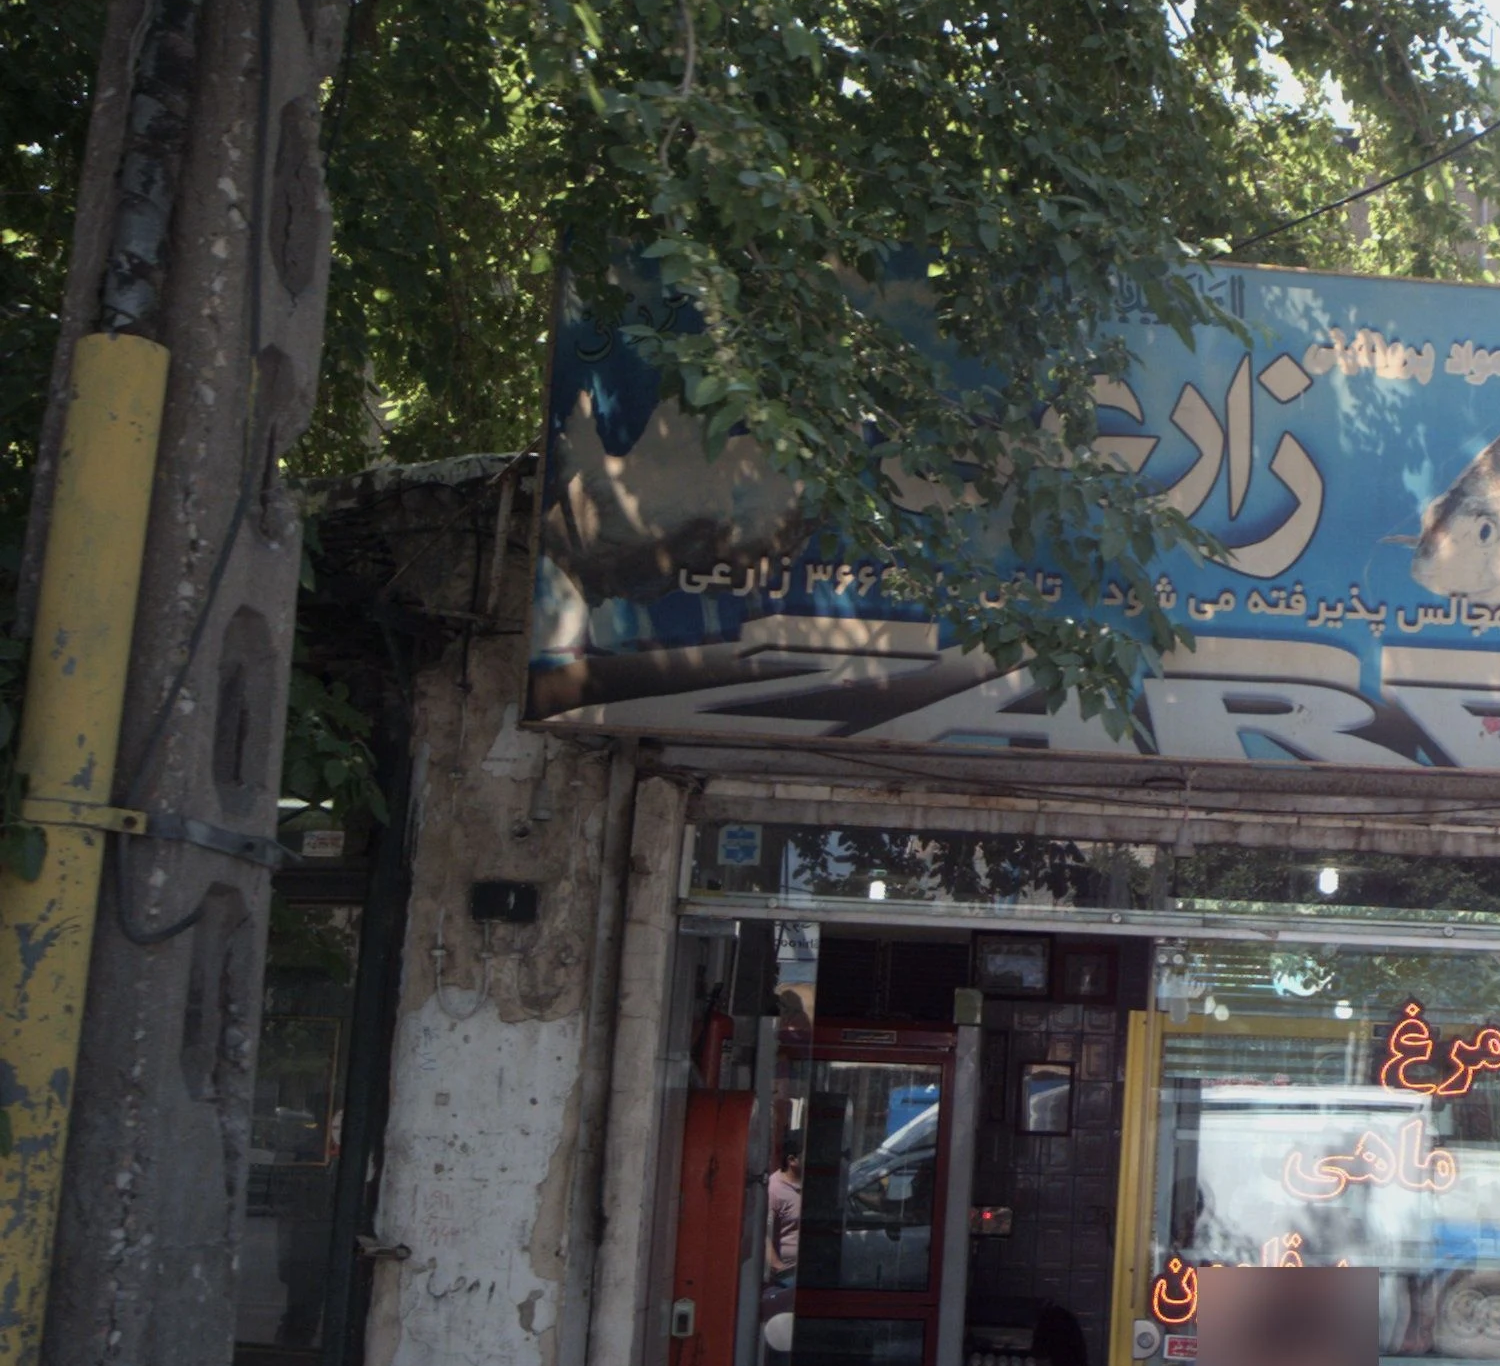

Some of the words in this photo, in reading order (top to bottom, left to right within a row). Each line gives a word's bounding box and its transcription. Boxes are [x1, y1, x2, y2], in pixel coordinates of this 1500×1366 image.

[678, 555, 793, 600] زارعی
[1102, 577, 1177, 618] شود
[1187, 591, 1237, 621] می
[1245, 582, 1388, 638] پذیرفته
[1283, 1118, 1457, 1200] ماهی
